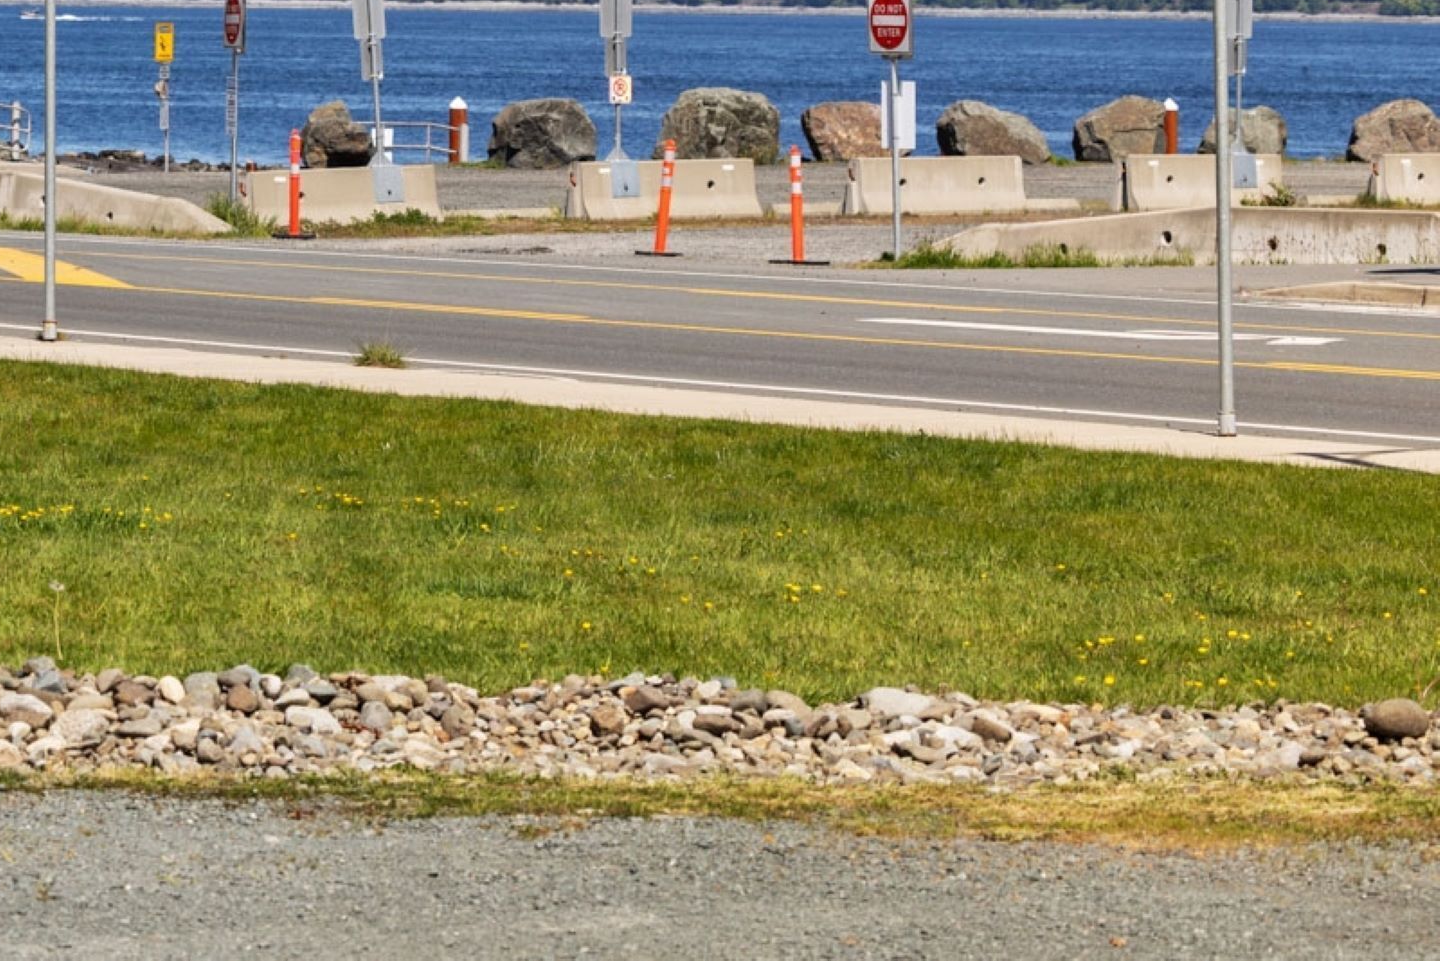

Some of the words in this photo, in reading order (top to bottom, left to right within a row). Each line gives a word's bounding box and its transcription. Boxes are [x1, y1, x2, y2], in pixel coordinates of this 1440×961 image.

[873, 4, 886, 14] DO
[887, 4, 903, 14] NOT
[877, 27, 901, 38] ENTER
